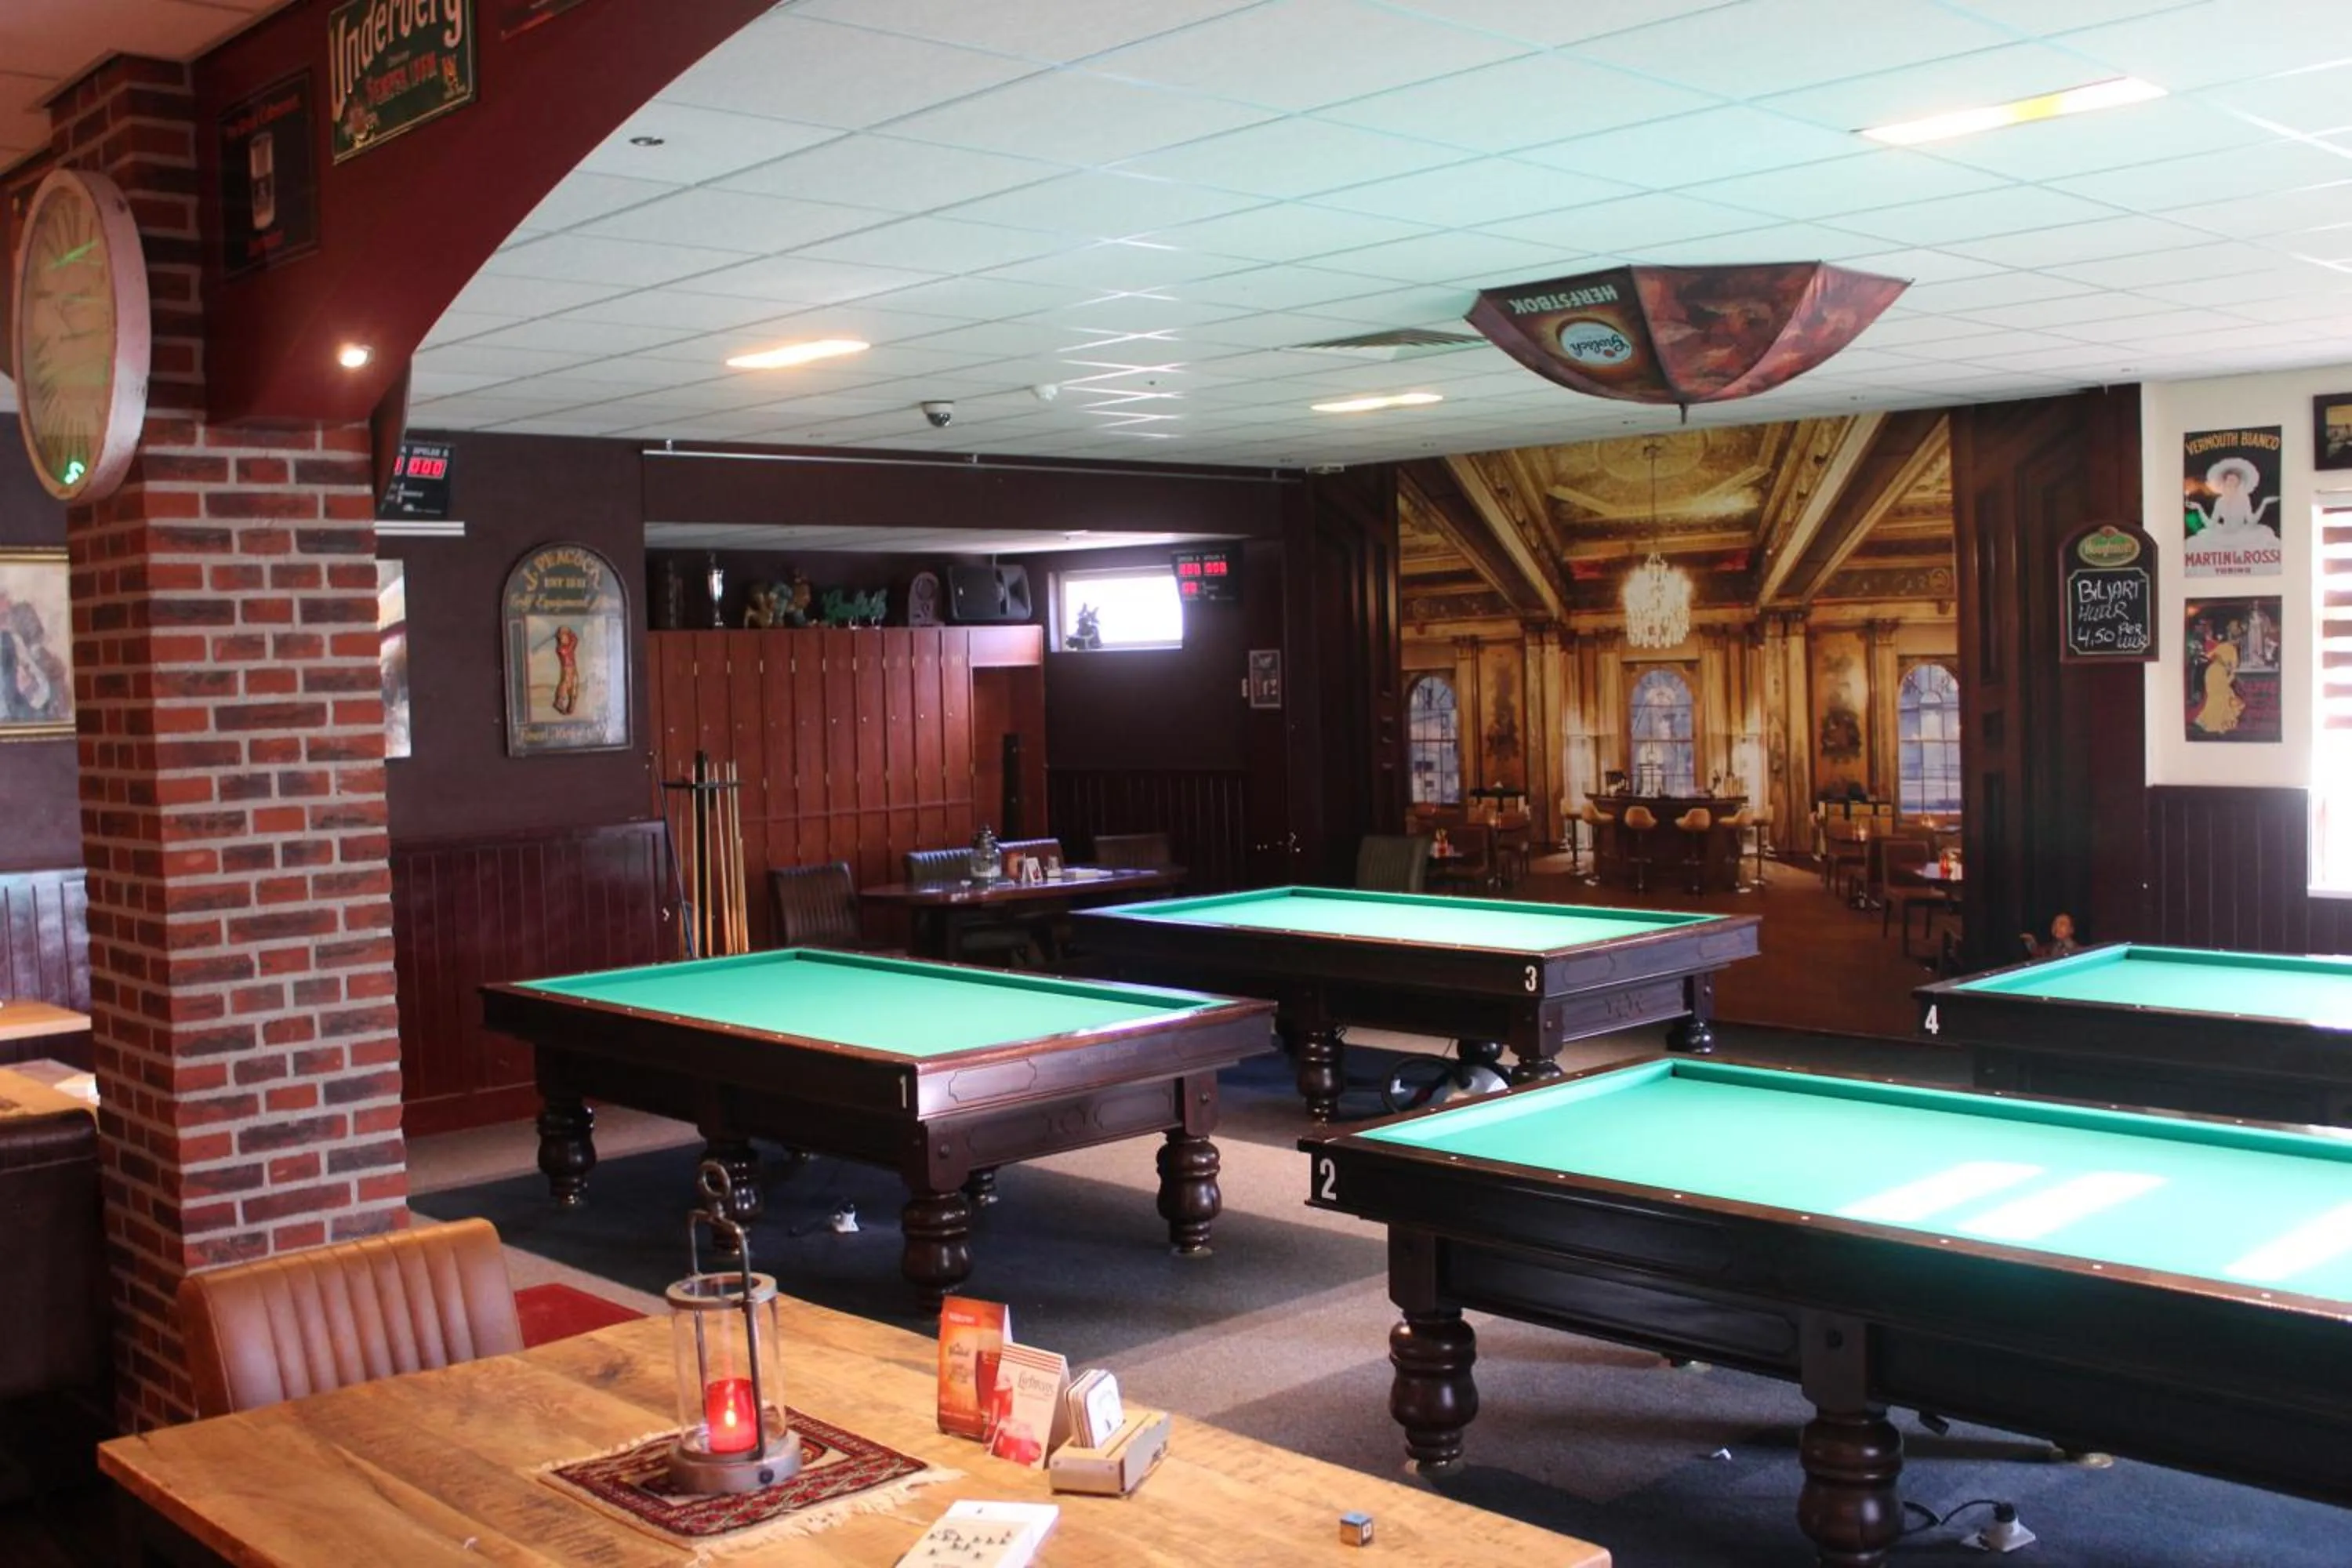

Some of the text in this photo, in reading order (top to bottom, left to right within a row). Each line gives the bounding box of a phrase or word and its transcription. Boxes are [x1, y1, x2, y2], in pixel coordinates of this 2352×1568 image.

[1508, 284, 1618, 314] HERFSTBOK
[1570, 335, 1629, 358] Grolsch
[2186, 431, 2279, 456] VERMOUTH BIANCO
[2243, 550, 2281, 564] ROSSI
[1525, 964, 1537, 992] 3
[1924, 1004, 1940, 1035] 4
[899, 1075, 907, 1109] 1
[1319, 1158, 1337, 1200] 2
